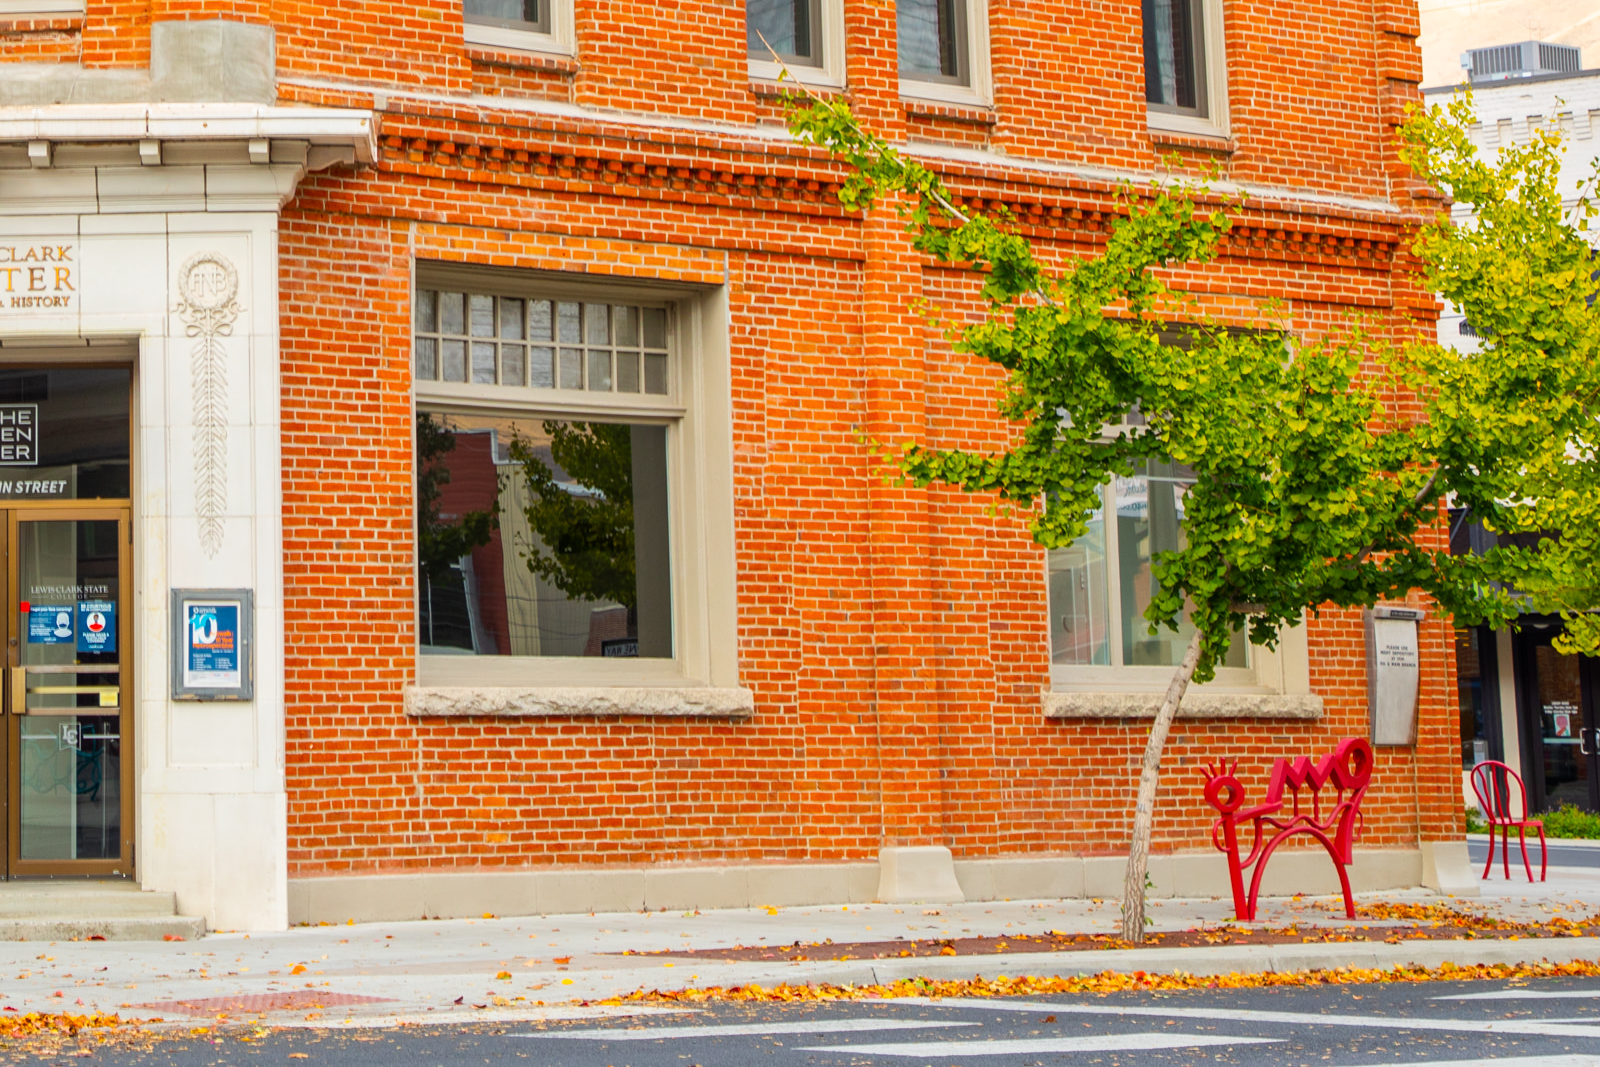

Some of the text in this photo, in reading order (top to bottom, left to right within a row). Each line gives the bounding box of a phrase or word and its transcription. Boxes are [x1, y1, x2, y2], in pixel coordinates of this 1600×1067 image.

[11, 296, 71, 308] HISTORY
[15, 480, 67, 494] STREET
[84, 585, 109, 593] STATE
